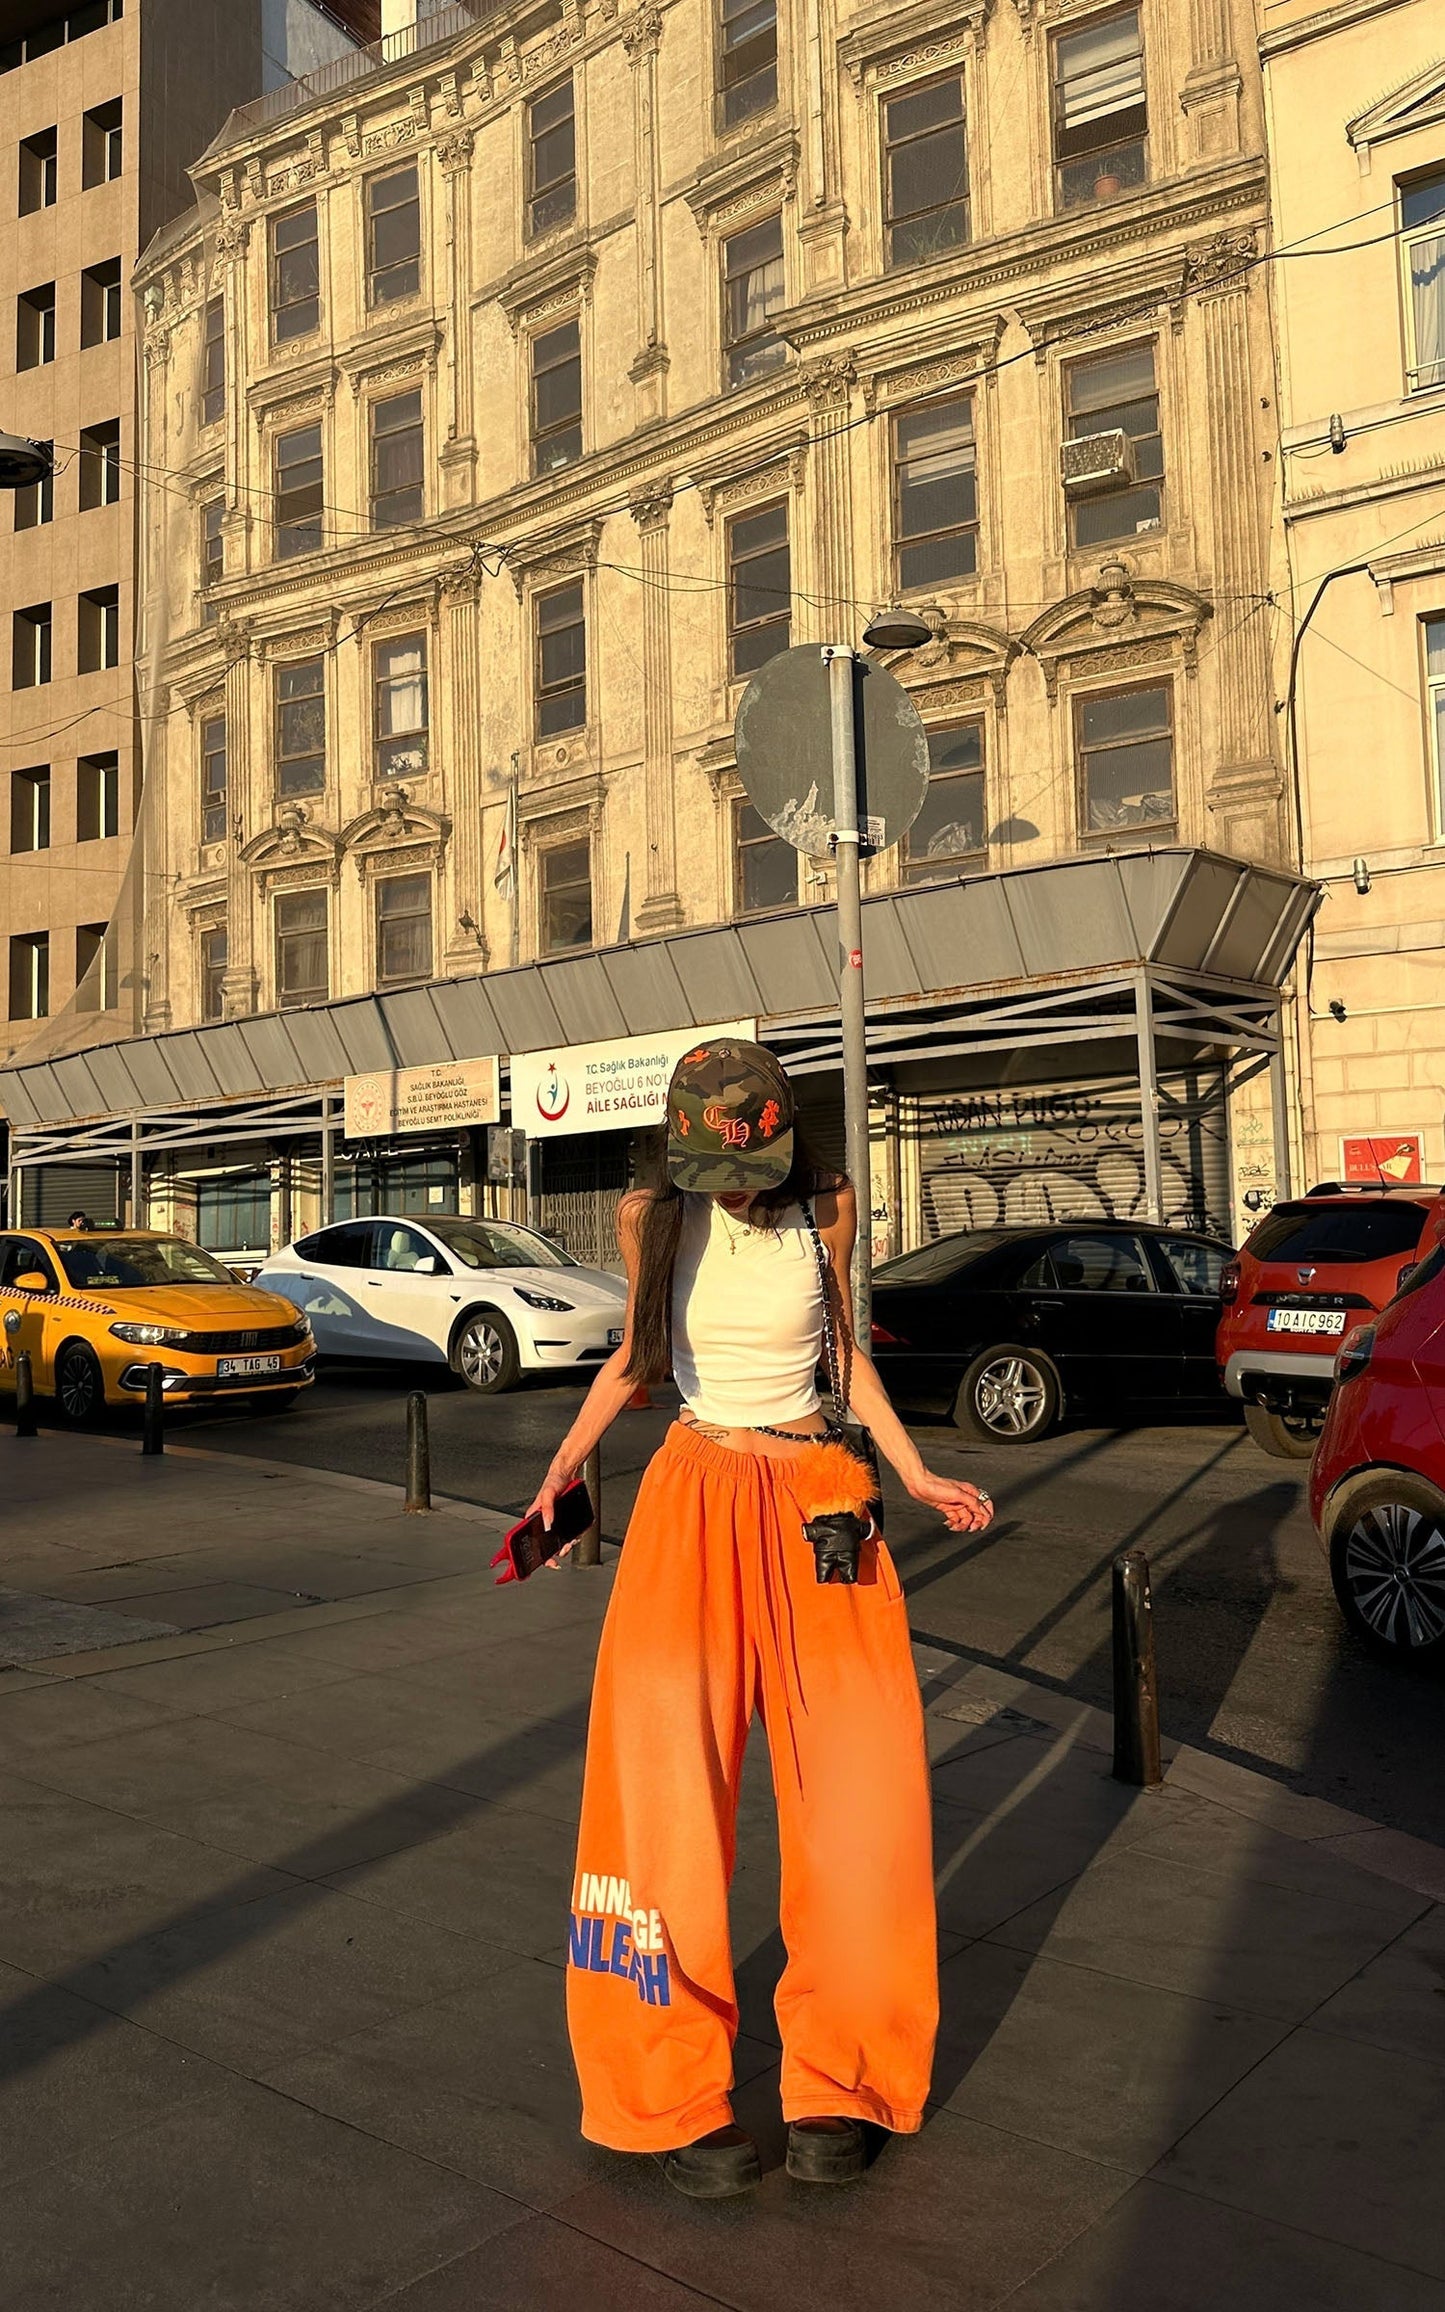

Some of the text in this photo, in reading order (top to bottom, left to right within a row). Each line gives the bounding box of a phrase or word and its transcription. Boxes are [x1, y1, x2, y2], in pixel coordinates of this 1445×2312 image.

[600, 1059, 626, 1075] Sağlık
[628, 1053, 669, 1069] Bakanlığı
[410, 1081, 432, 1092] SAĞLIK
[585, 1073, 671, 1095] BEYOĞLU 6 NO'L
[425, 1090, 453, 1101] BEYOĞLU
[454, 1088, 468, 1097] GÖZ
[587, 1097, 611, 1114] AİLE
[613, 1090, 659, 1111] SAĞLIĞI
[410, 1106, 417, 1115] VE
[418, 1101, 453, 1115] ARAŞTIRMA
[398, 1115, 425, 1127] BEYOĞLU
[426, 1115, 442, 1124] SEMT
[1277, 1312, 1343, 1330] 10 AIC 962
[223, 1360, 236, 1373] 34
[243, 1359, 261, 1371] TAG
[267, 1357, 278, 1369] 45
